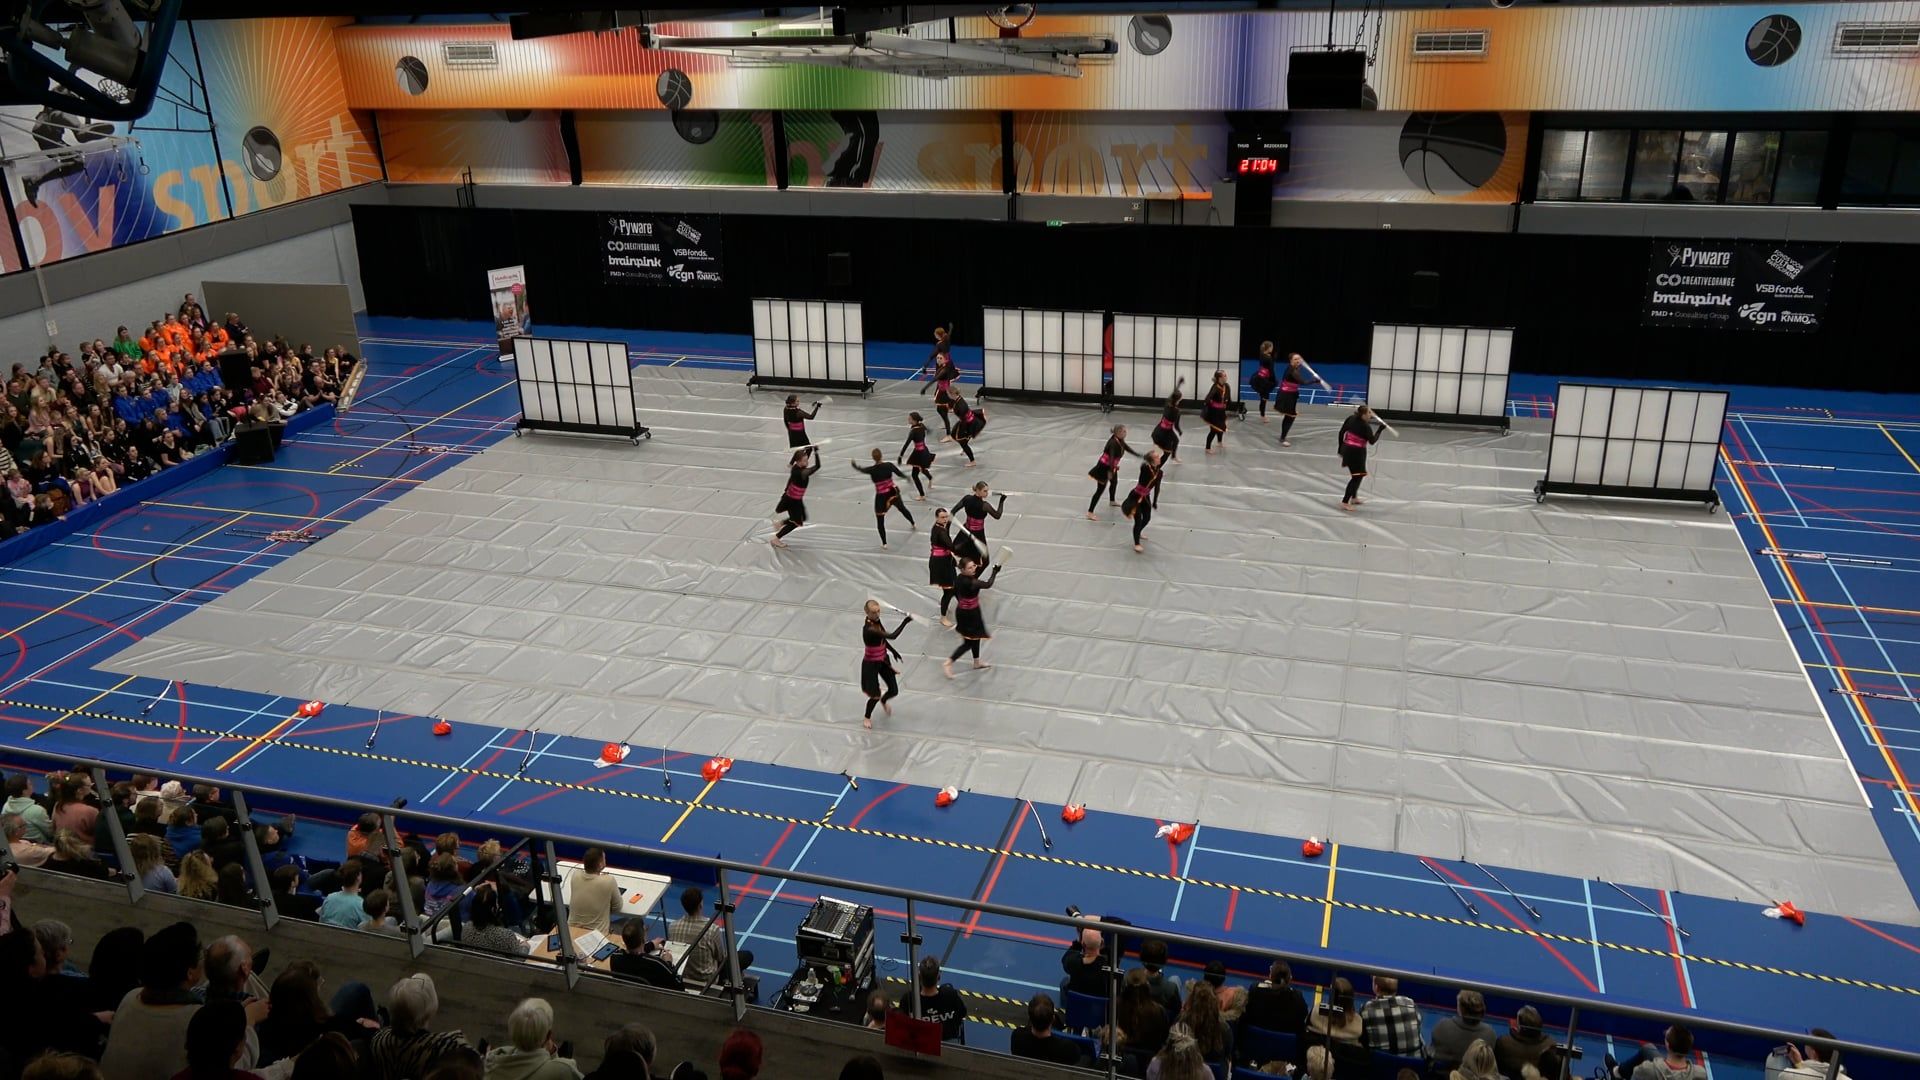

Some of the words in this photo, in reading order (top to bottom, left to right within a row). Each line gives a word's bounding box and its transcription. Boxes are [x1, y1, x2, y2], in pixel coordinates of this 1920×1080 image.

[1239, 159, 1278, 171] 21:04
[619, 219, 653, 236] Pyware
[608, 254, 662, 268] brainpink
[1682, 247, 1731, 267] Pyware
[675, 271, 695, 282] cgn
[1652, 291, 1732, 307] brainpink
[1675, 311, 1708, 320] Consulting
[1709, 312, 1730, 321] Group
[1749, 310, 1777, 324] cgn
